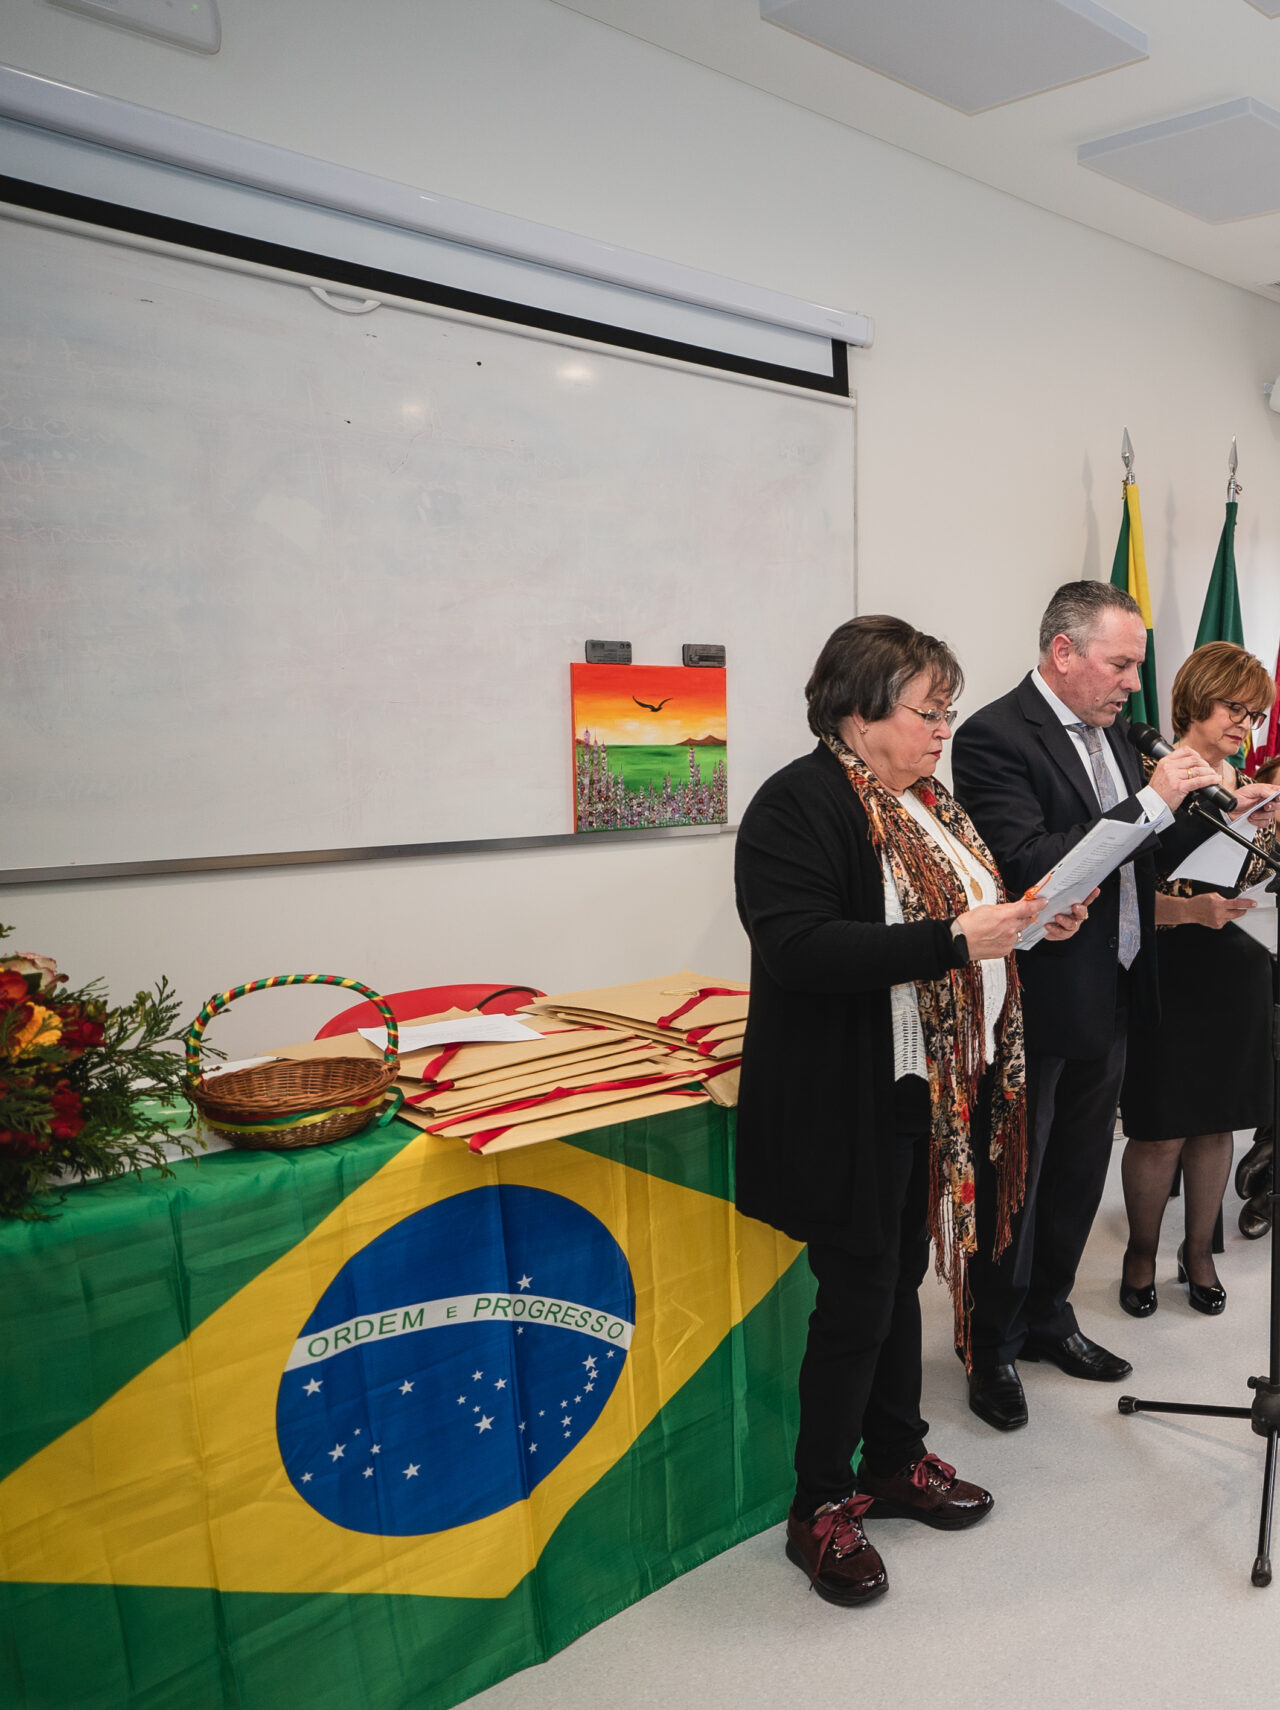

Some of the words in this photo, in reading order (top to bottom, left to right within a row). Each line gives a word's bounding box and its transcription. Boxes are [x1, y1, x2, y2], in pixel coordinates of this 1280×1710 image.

[307, 1308, 425, 1358] ORDEM
[446, 1305, 459, 1319] E
[473, 1297, 625, 1340] PROGRESSO
